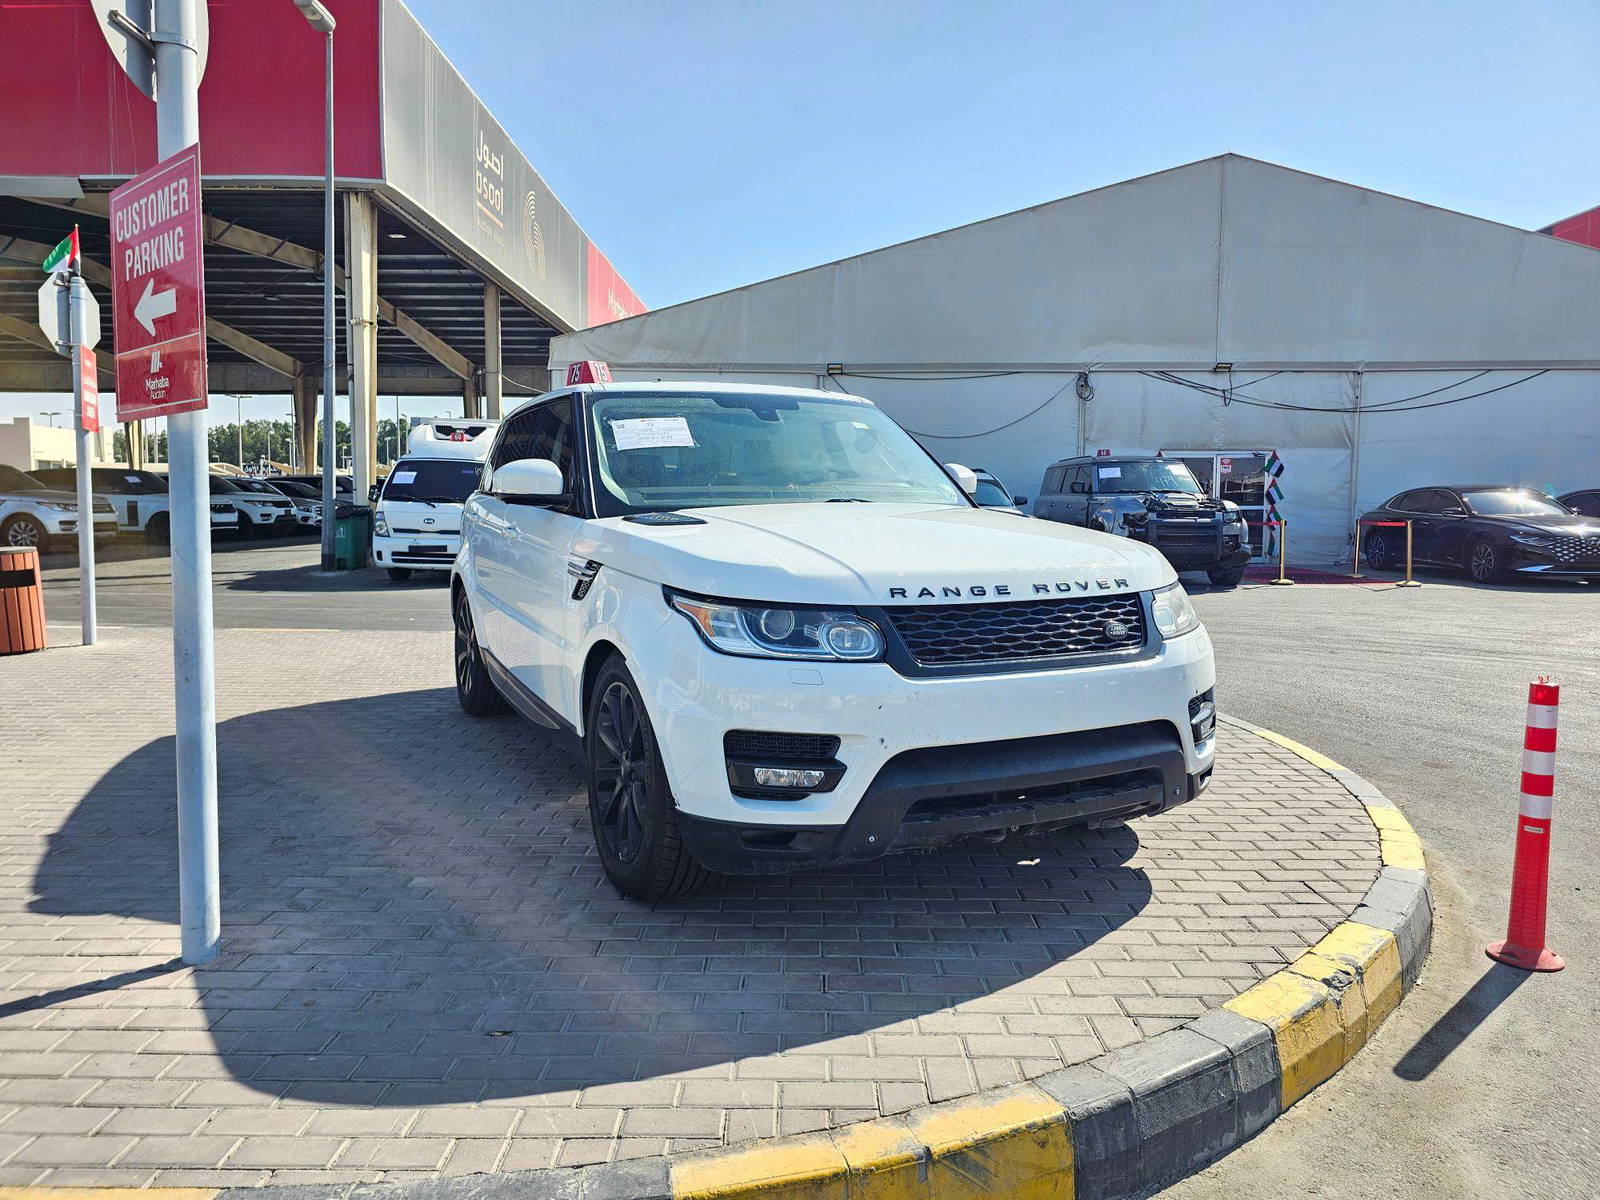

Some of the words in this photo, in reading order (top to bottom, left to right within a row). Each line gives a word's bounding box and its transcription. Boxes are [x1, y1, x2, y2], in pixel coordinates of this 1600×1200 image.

[116, 177, 189, 243] CUSTOMER
[125, 226, 184, 281] PARKING
[145, 376, 169, 391] Marhaba
[570, 364, 581, 385] 75
[889, 584, 1011, 599] RANGE
[1032, 577, 1130, 594] ROVER
